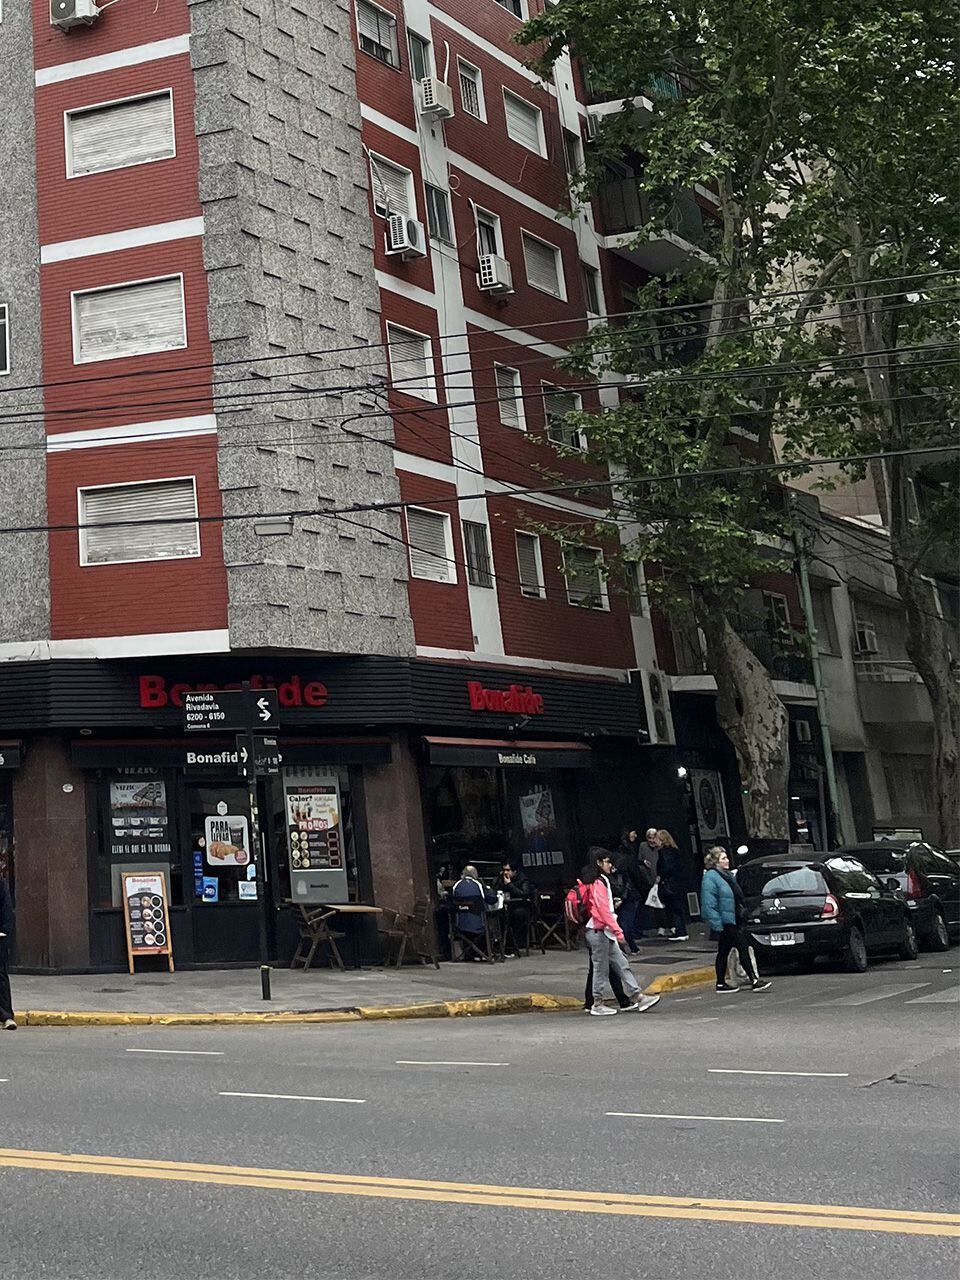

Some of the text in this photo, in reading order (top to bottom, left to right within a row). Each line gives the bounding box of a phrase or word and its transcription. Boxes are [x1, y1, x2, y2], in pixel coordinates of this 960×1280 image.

[139, 675, 328, 707] Bode
[185, 694, 214, 702] Avenida
[467, 681, 544, 715] Bonafide
[185, 703, 219, 711] Rivadavia
[186, 713, 203, 721] 6200
[209, 712, 225, 720] 6150
[186, 751, 239, 764] Bonafid
[497, 753, 523, 765] Bonafide
[289, 795, 313, 803] Calor?
[210, 821, 229, 832] PARA
[298, 819, 328, 831] PROMOS
